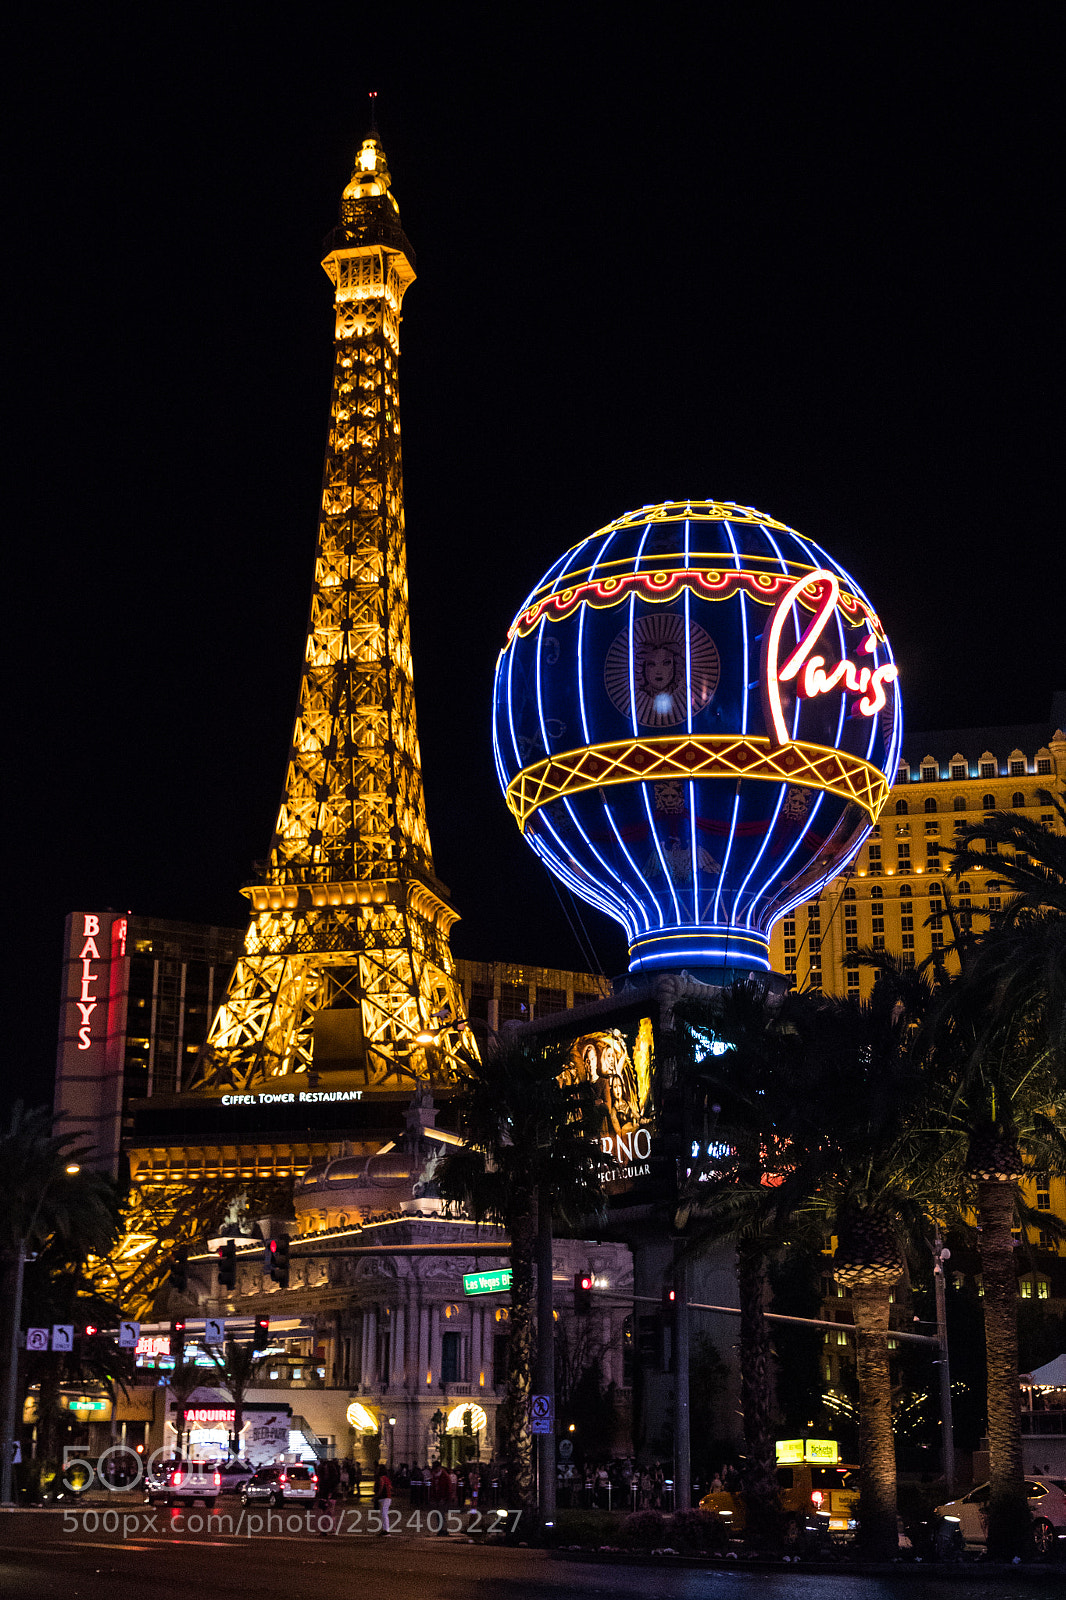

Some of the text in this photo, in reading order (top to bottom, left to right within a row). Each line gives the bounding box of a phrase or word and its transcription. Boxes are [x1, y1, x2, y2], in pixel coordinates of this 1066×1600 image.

[762, 569, 899, 746] Paris
[77, 914, 101, 1050] BALLYS
[221, 1090, 363, 1106] EIFFEL TOWER RESTAURANT
[465, 1273, 513, 1291] Las Vegas Bl
